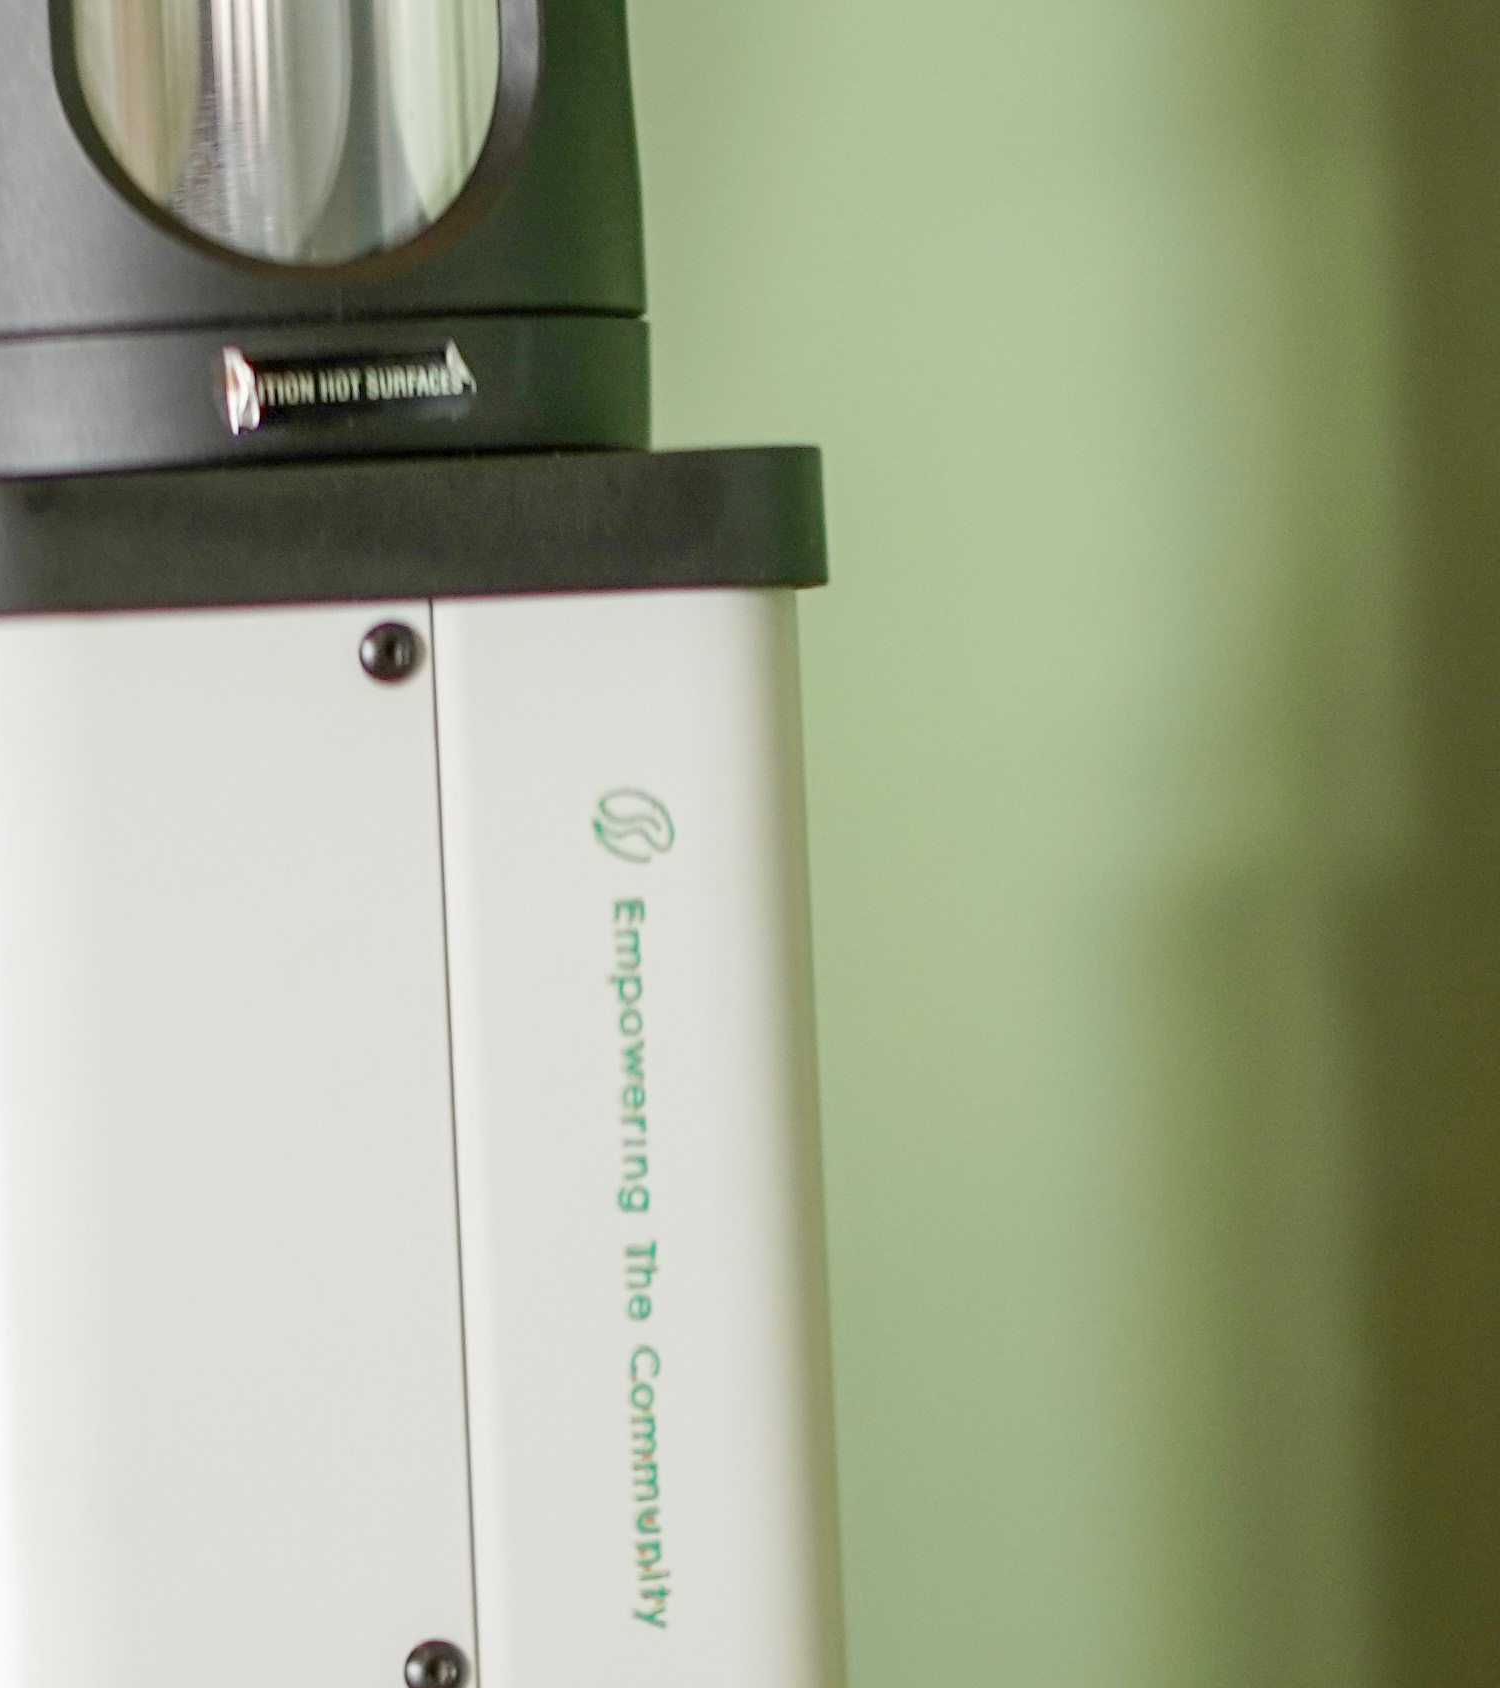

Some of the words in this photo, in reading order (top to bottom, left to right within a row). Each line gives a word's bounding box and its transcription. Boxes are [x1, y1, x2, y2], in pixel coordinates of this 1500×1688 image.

[318, 366, 363, 404] HOT
[607, 896, 651, 1215] Empowering
[624, 1239, 658, 1323] The
[629, 1343, 672, 1630] Community
